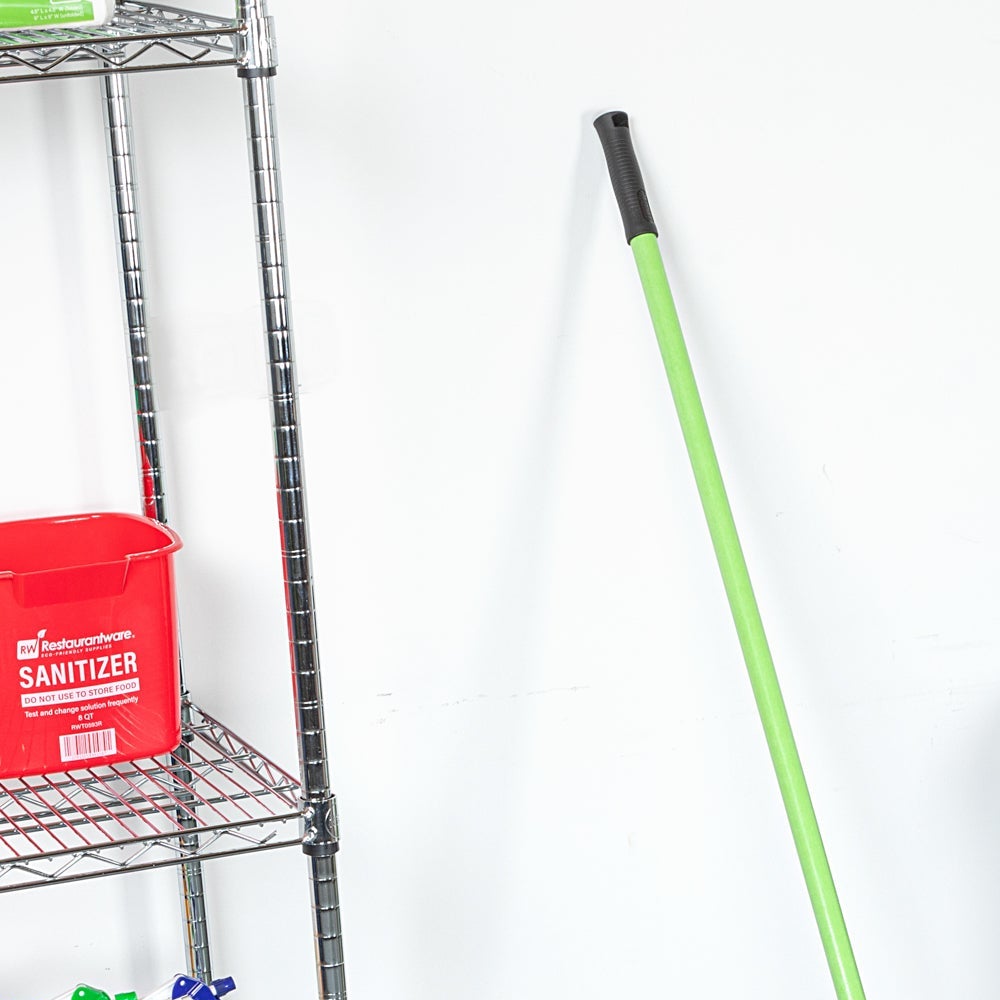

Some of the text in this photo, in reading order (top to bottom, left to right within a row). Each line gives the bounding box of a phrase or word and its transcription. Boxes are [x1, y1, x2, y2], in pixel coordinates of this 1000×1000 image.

[20, 640, 38, 655] RW
[41, 644, 112, 658] ECO-FRIENDLY SUPPLIES
[19, 652, 138, 688] SANITIZER
[24, 681, 137, 704] DO NOT USE TO STORE FOOD
[24, 695, 138, 718] Test and change solution frequently
[84, 712, 94, 720] QT
